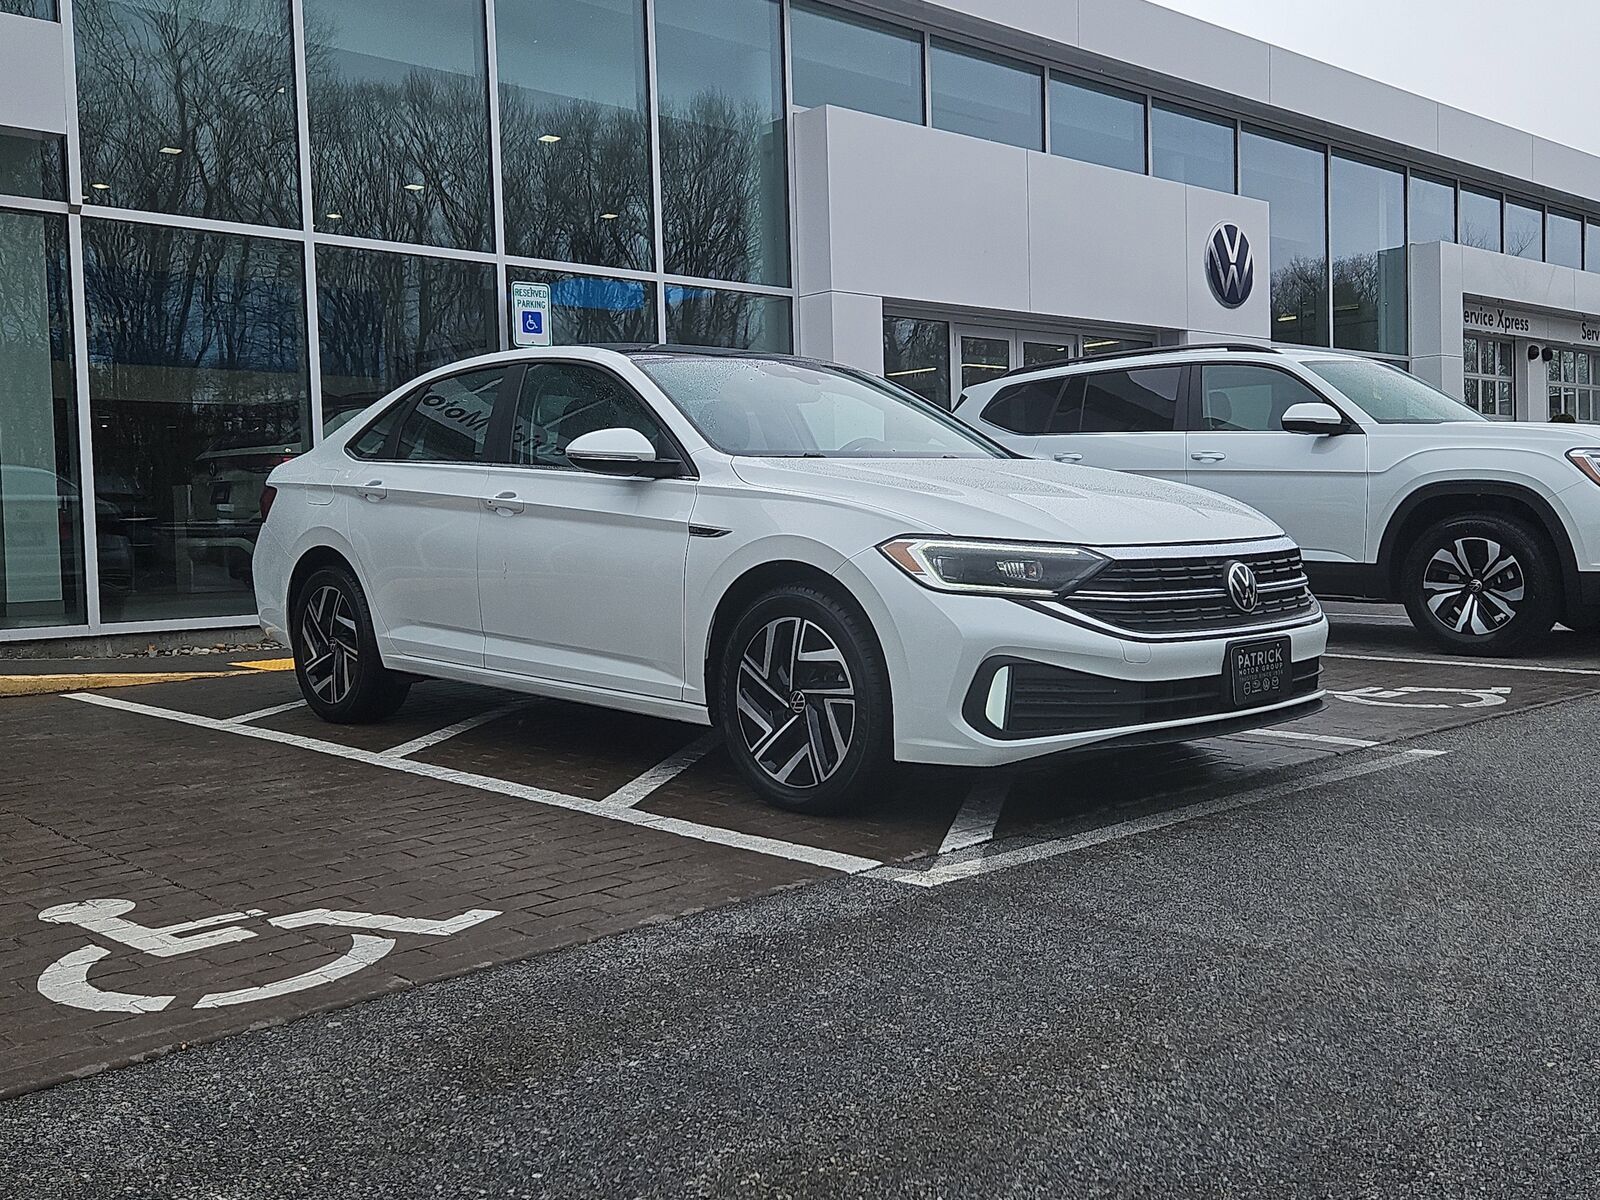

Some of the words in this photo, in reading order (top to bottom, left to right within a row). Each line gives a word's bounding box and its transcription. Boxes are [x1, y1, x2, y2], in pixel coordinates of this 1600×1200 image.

[514, 288, 547, 299] RESERVED
[517, 299, 546, 310] PARKING
[1463, 307, 1494, 326] ervice
[1496, 309, 1529, 333] Xpress
[1581, 322, 1600, 342] Serv
[1238, 648, 1283, 669] PATRICK
[1238, 667, 1259, 676] MOTOR
[1261, 662, 1284, 672] GROUP
